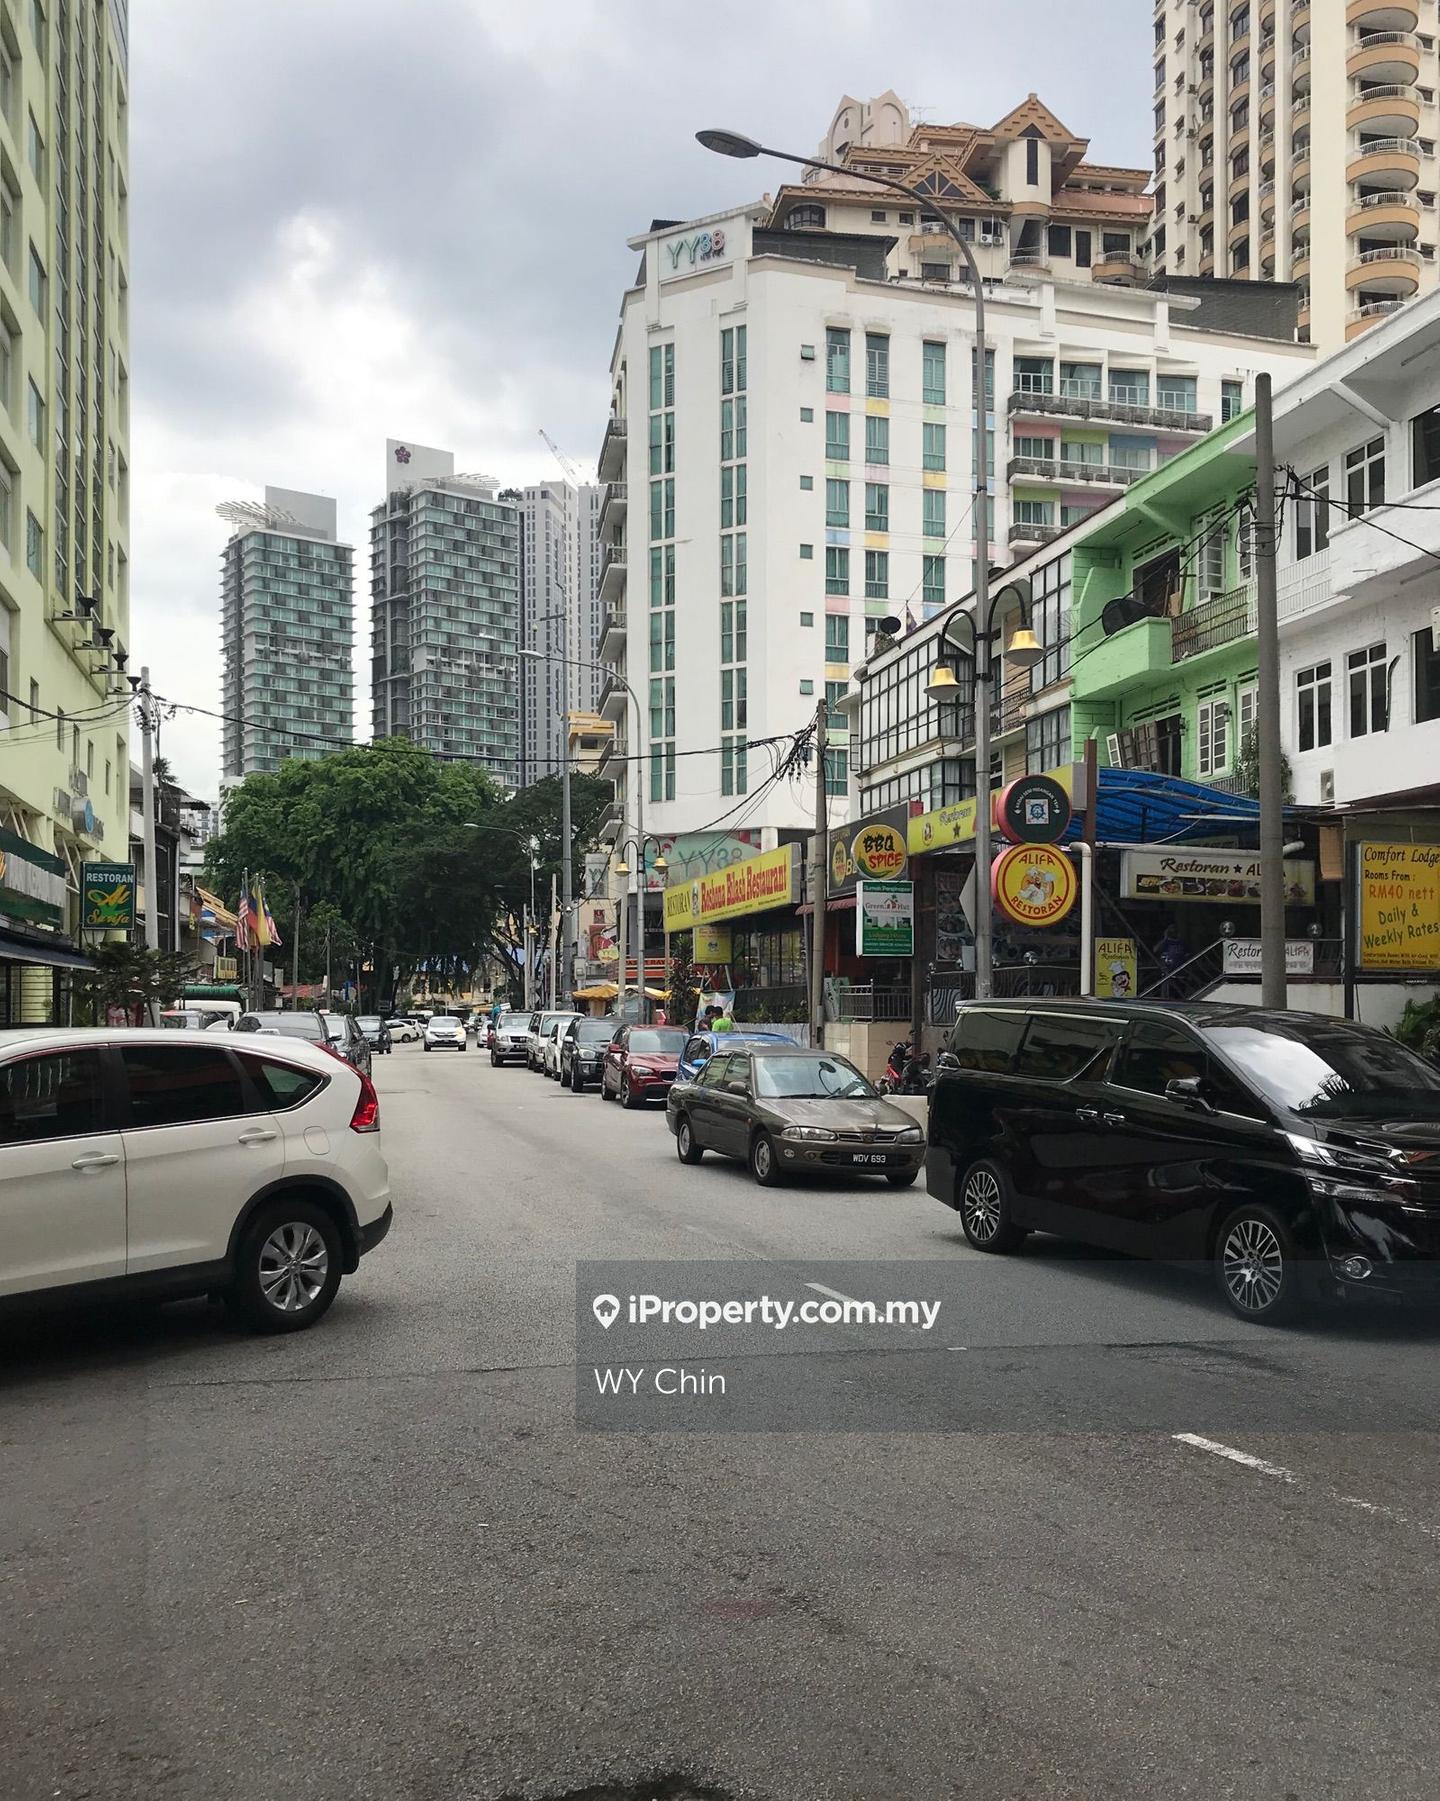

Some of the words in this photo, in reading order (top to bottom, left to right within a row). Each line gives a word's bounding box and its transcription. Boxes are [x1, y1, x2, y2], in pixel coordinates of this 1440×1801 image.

[863, 833, 895, 853] BBQ
[868, 852, 903, 869] SPICE
[1019, 853, 1056, 866] ALIFA
[1364, 846, 1406, 866] Comfort
[1411, 847, 1440, 868] Lodge
[1160, 858, 1229, 874] Restoran
[86, 872, 134, 883] RESTORAN
[1365, 869, 1389, 881] Rooms
[1369, 884, 1404, 900] RM40
[1408, 887, 1435, 901] nett
[1011, 895, 1063, 915] RESTORAN
[1378, 905, 1406, 925] Daily
[1411, 902, 1419, 917] &
[1364, 927, 1404, 948] Weekly
[1407, 922, 1440, 938] Rates
[1099, 942, 1133, 953] ALIFA
[1227, 942, 1261, 959] Restor
[870, 1154, 886, 1163] 693
